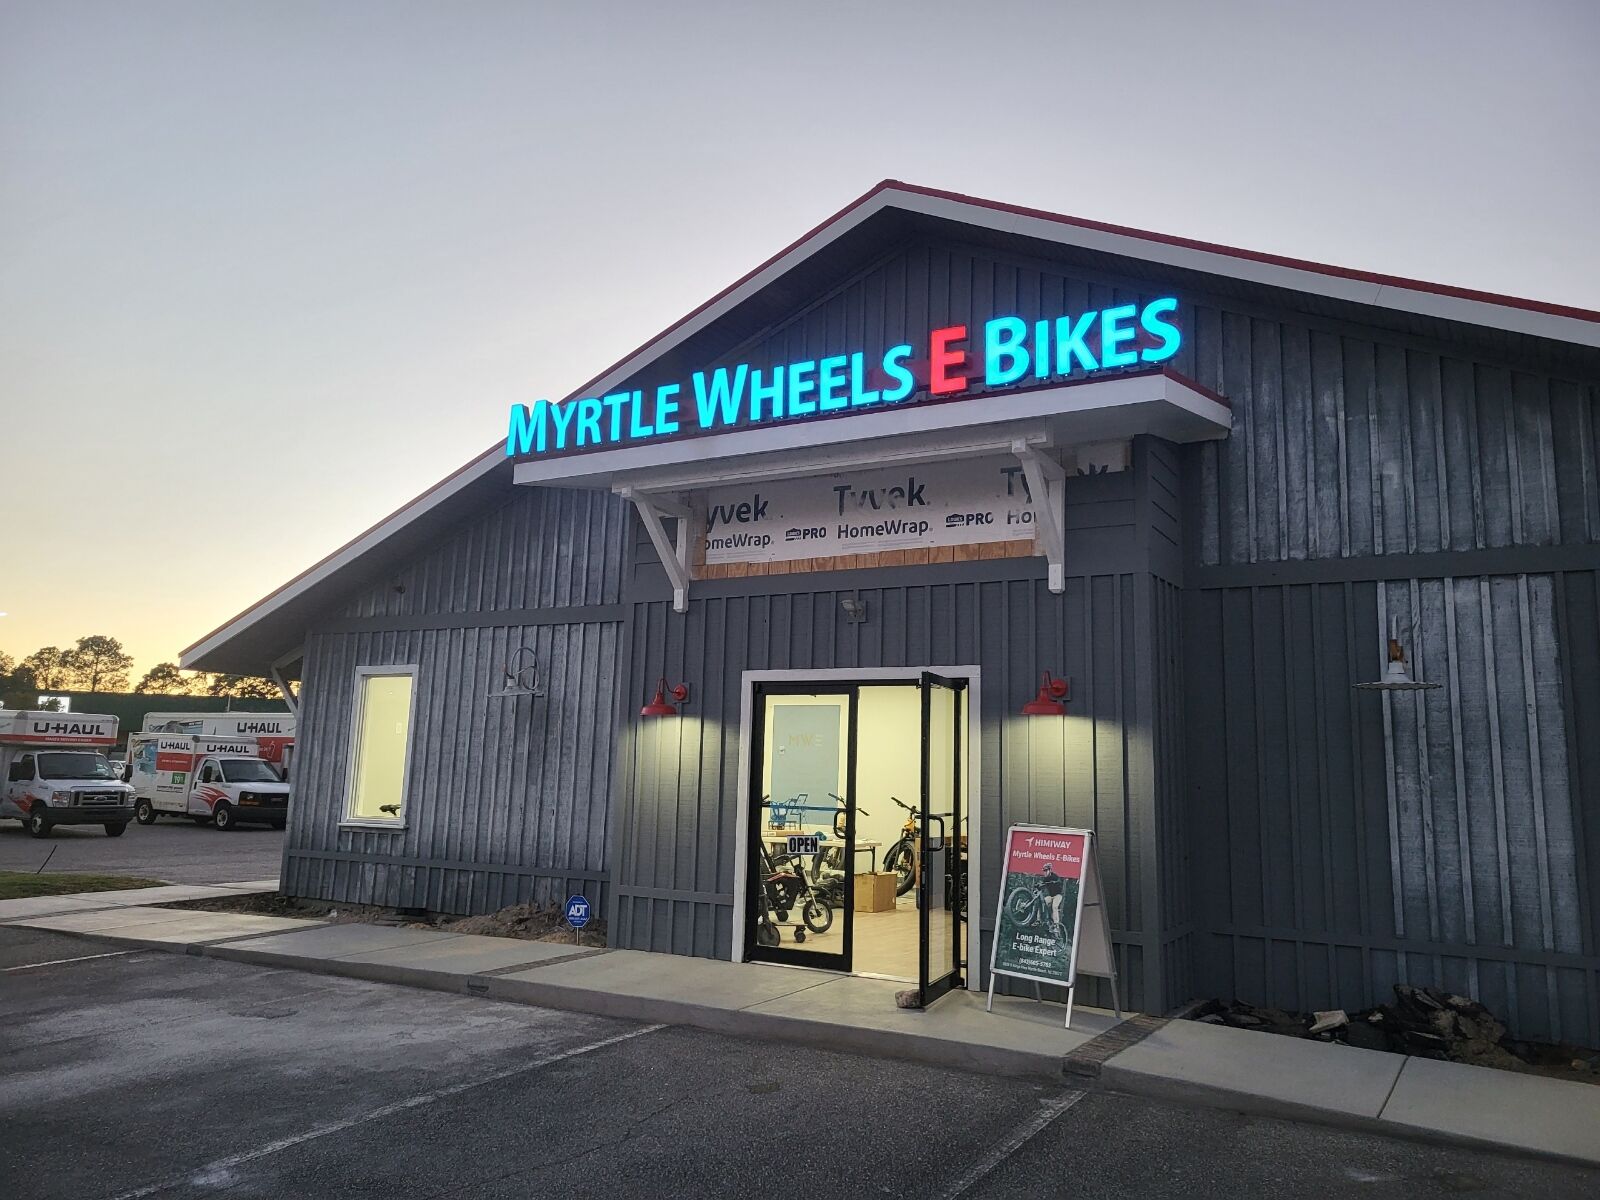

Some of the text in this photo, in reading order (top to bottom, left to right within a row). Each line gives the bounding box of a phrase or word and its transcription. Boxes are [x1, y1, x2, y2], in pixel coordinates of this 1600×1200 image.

[506, 298, 1181, 456] MYRTLE WHEELS E BIKES
[706, 494, 769, 533] yvek
[803, 527, 826, 540] PRO
[705, 533, 772, 551] omeWrap
[33, 722, 105, 735] U-HAUL
[237, 722, 282, 734] U-HAUL
[160, 741, 190, 750] U-HAUL
[206, 744, 250, 753] U-HAUL
[789, 837, 818, 852] OPEN
[1034, 839, 1071, 849] HIMIWAY
[1012, 850, 1080, 863] Myrtle Wheels E-Bikes
[568, 904, 587, 916] ADT
[1016, 932, 1056, 946] Long Range
[1012, 942, 1057, 957] E-bike Expert
